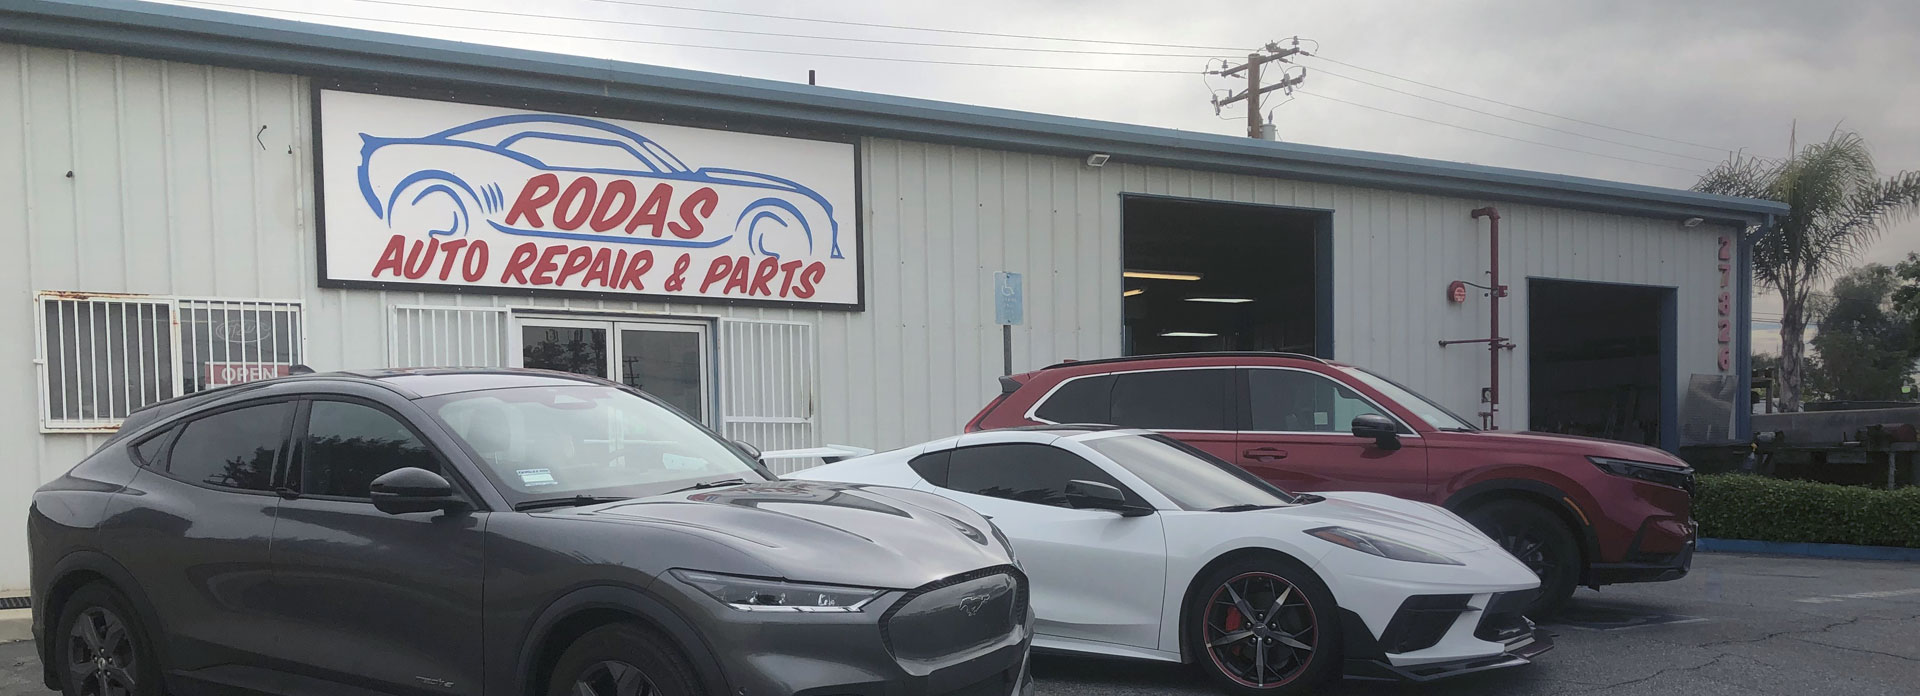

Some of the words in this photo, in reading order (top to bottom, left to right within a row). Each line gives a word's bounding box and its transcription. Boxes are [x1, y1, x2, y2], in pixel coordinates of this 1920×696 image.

[505, 173, 718, 238] RODAS
[372, 235, 488, 282] AUTO
[501, 242, 654, 292] REPAIR
[664, 253, 691, 292] &
[699, 256, 826, 299] PARTS
[221, 367, 274, 382] OPEN
